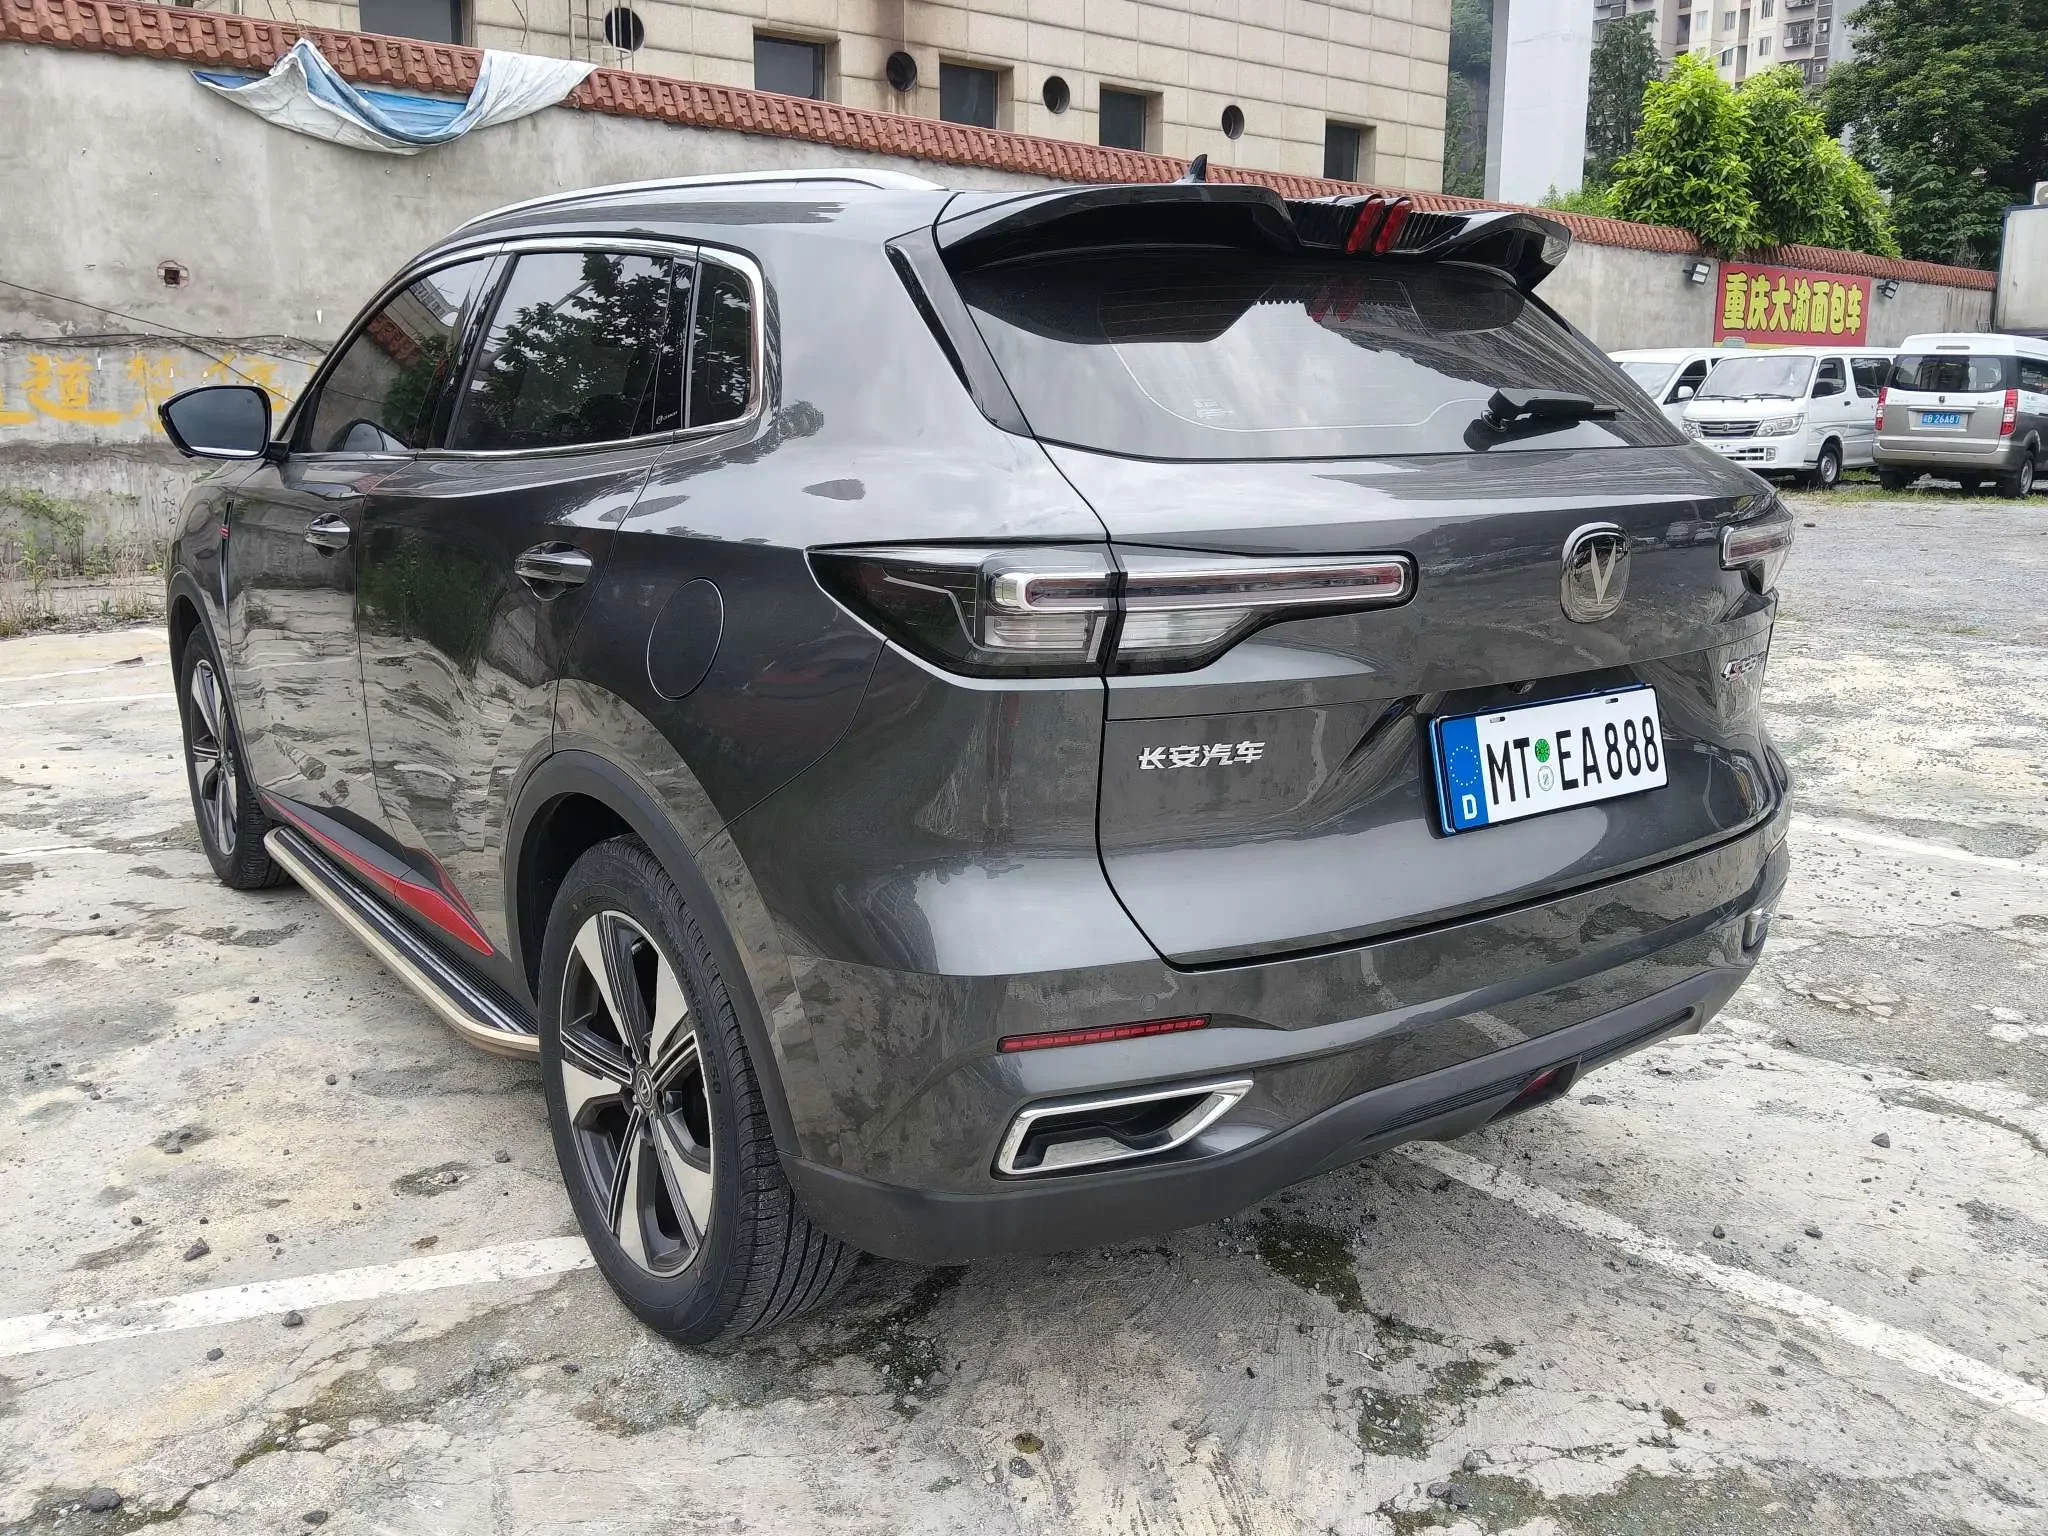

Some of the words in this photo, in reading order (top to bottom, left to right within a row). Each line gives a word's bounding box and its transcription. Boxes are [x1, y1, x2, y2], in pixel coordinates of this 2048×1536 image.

[1722, 271, 1863, 335] 重庆大渝面包车
[1138, 740, 1266, 770] 长安汽车
[1486, 737, 1531, 805] MT
[1555, 715, 1659, 791] EA888
[1461, 793, 1478, 820] D
